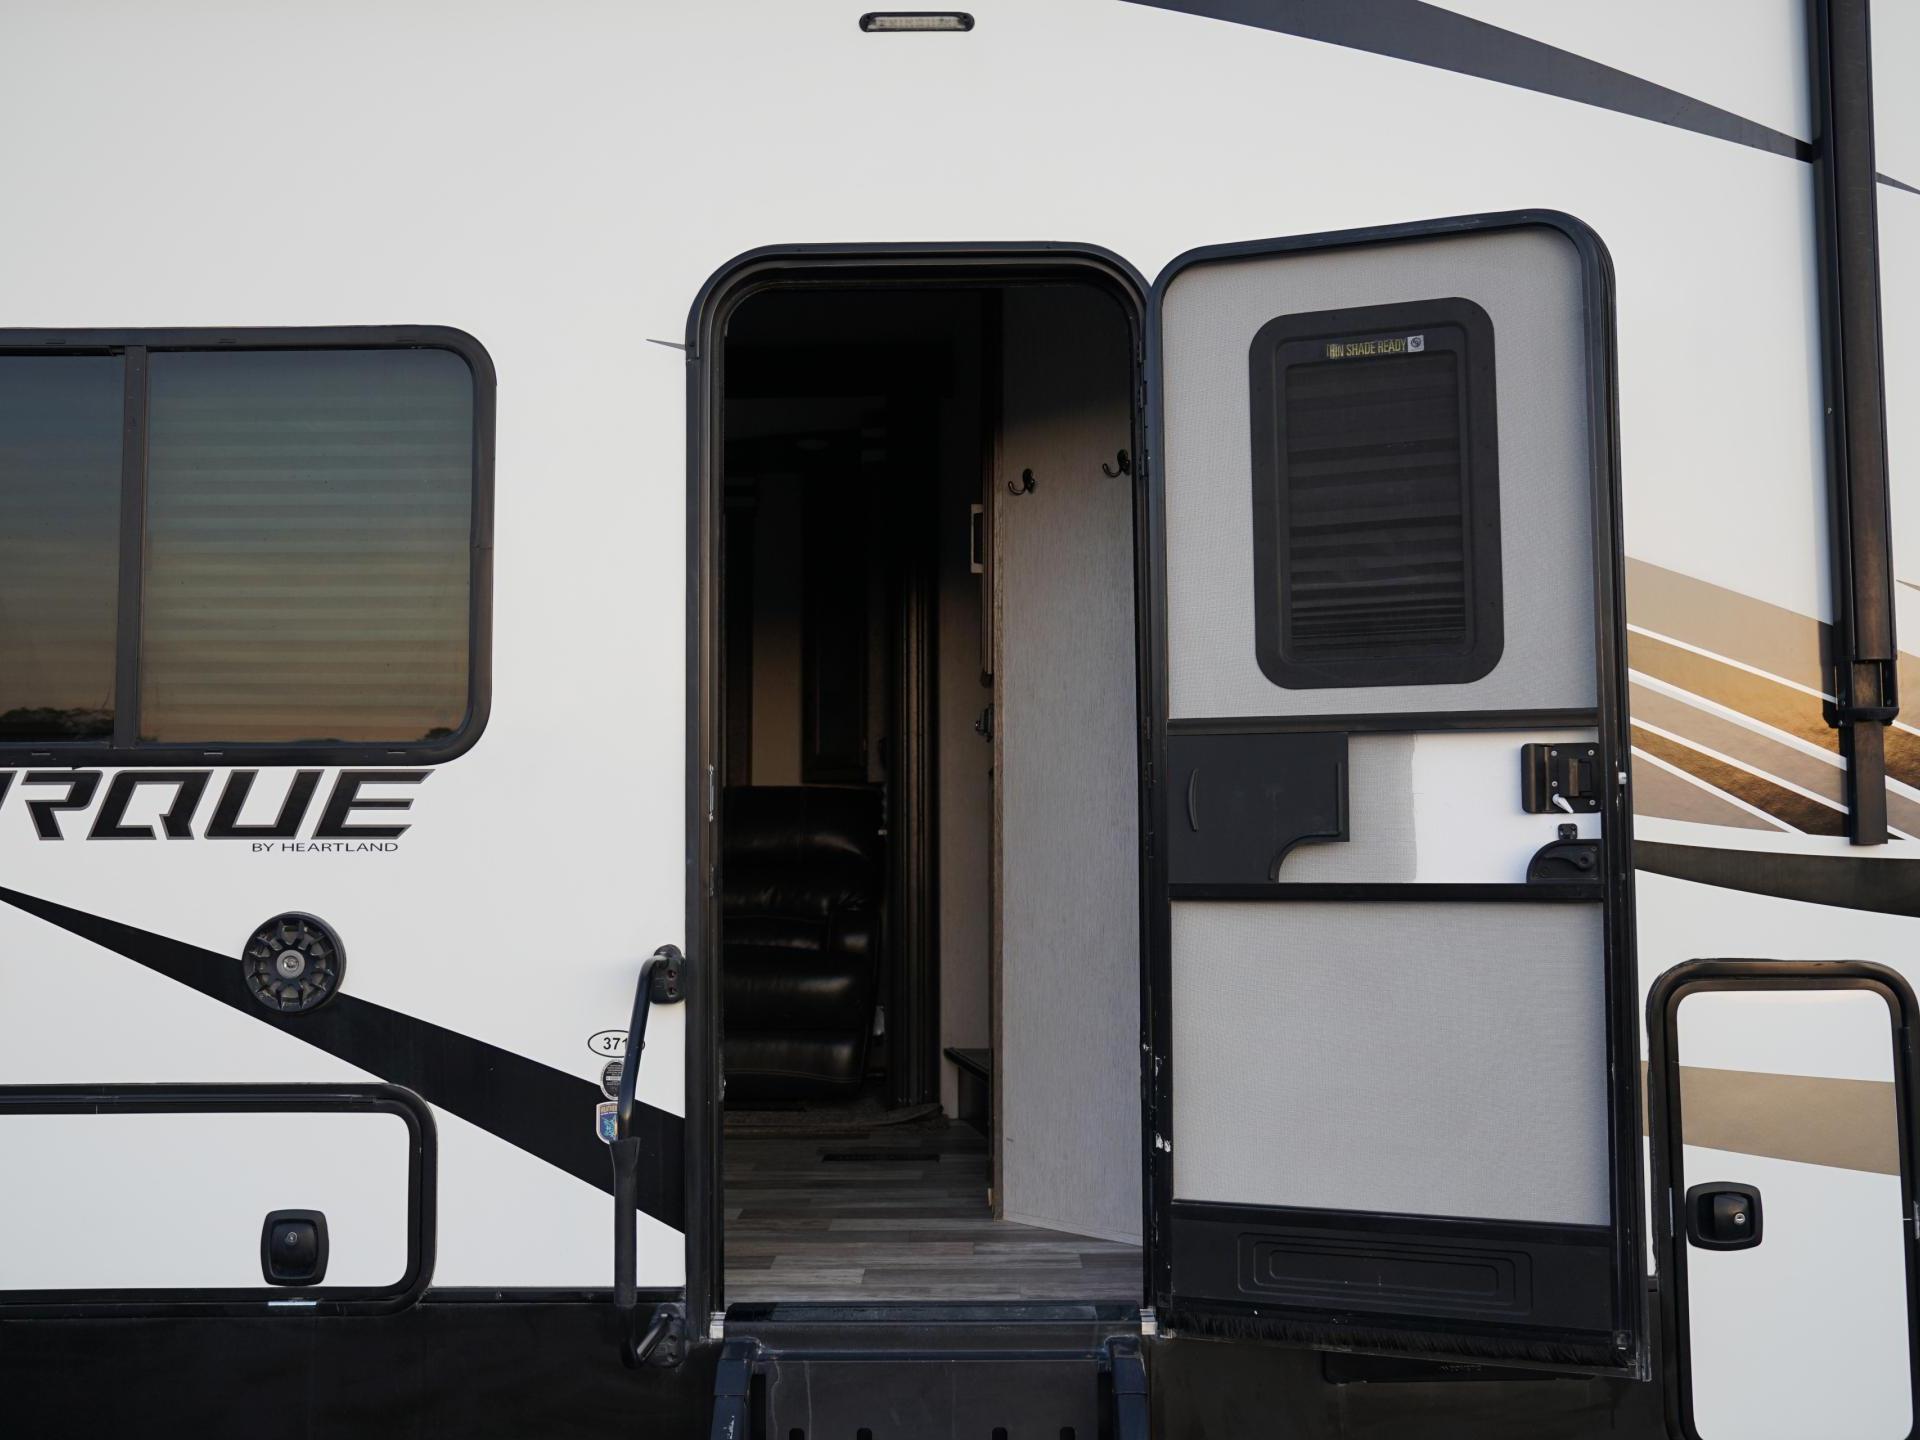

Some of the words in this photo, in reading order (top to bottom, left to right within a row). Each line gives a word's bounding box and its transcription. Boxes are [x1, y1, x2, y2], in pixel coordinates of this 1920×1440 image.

[1346, 341, 1376, 356] SHADE
[1377, 338, 1406, 353] READY
[0, 769, 436, 841] RQUE
[252, 842, 274, 852] BY
[281, 842, 399, 852] HEARTLAND
